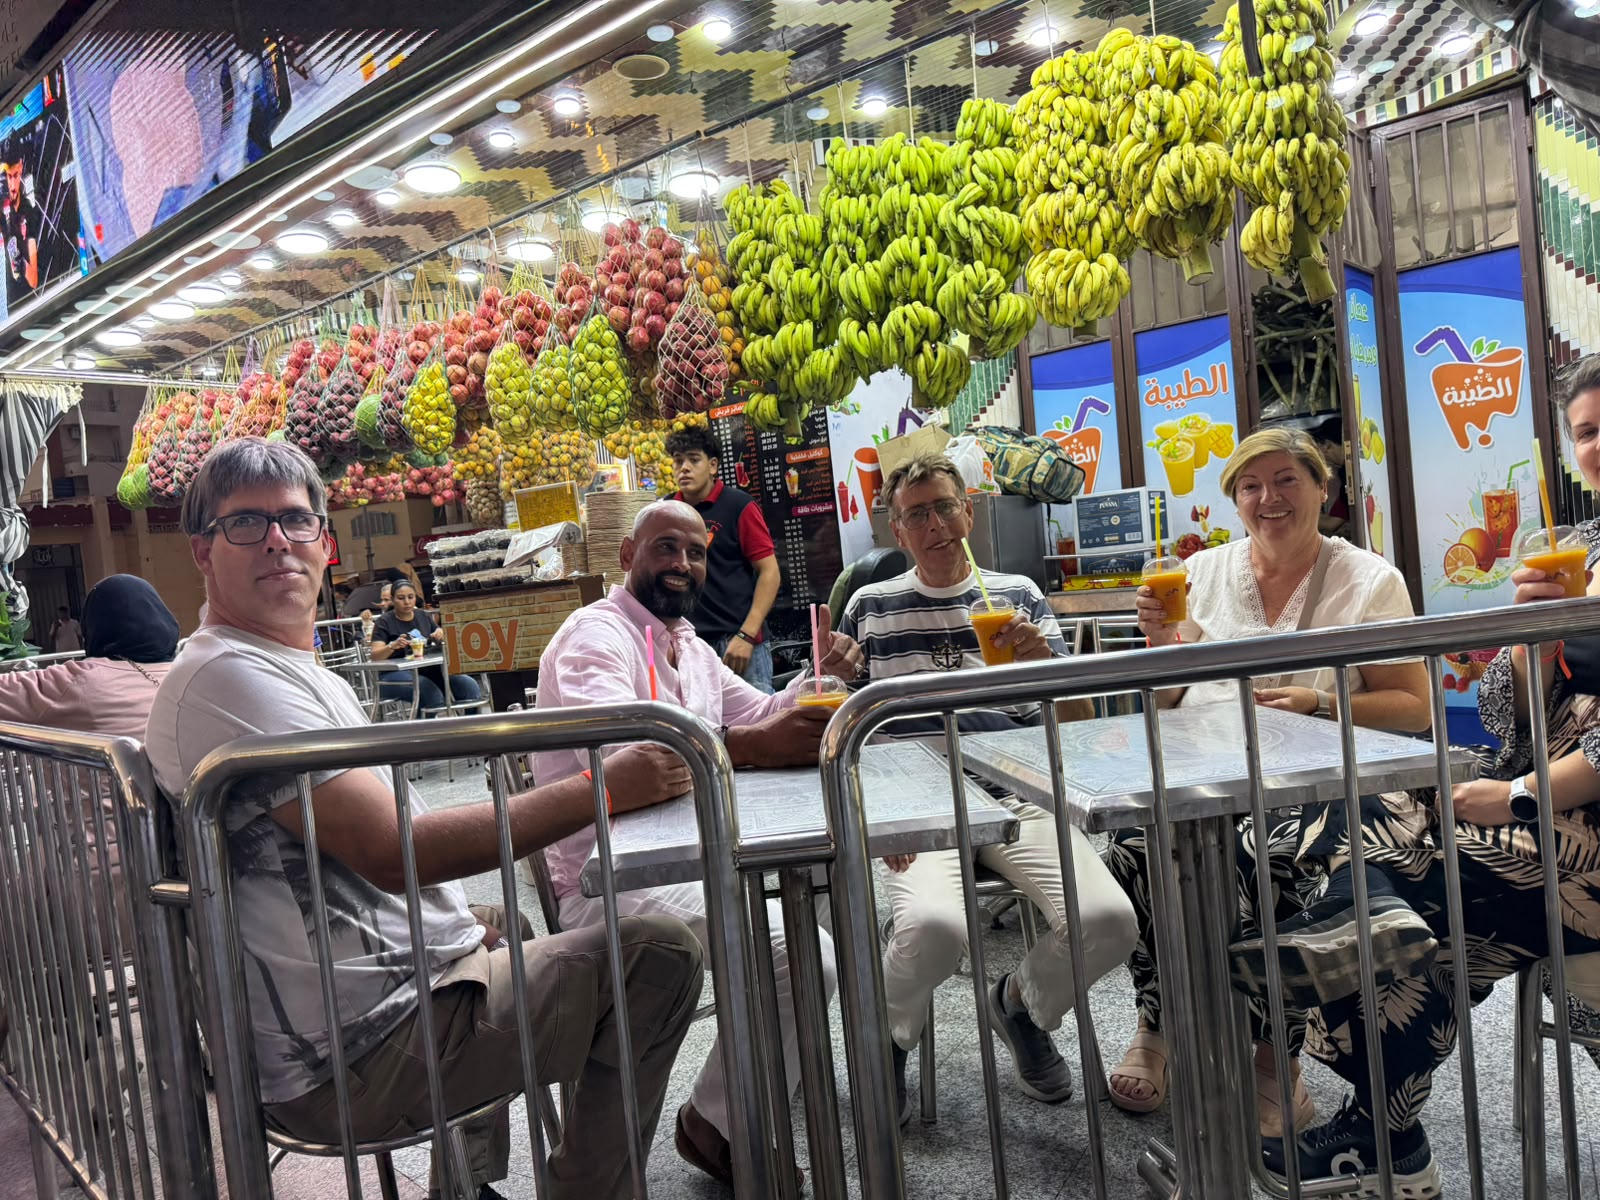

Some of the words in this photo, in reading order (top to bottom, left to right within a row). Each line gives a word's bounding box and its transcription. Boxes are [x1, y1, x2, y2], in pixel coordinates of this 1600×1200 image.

[1144, 363, 1228, 410] الطيبة
[1442, 376, 1512, 408] الطيبة
[445, 613, 519, 674] joy
